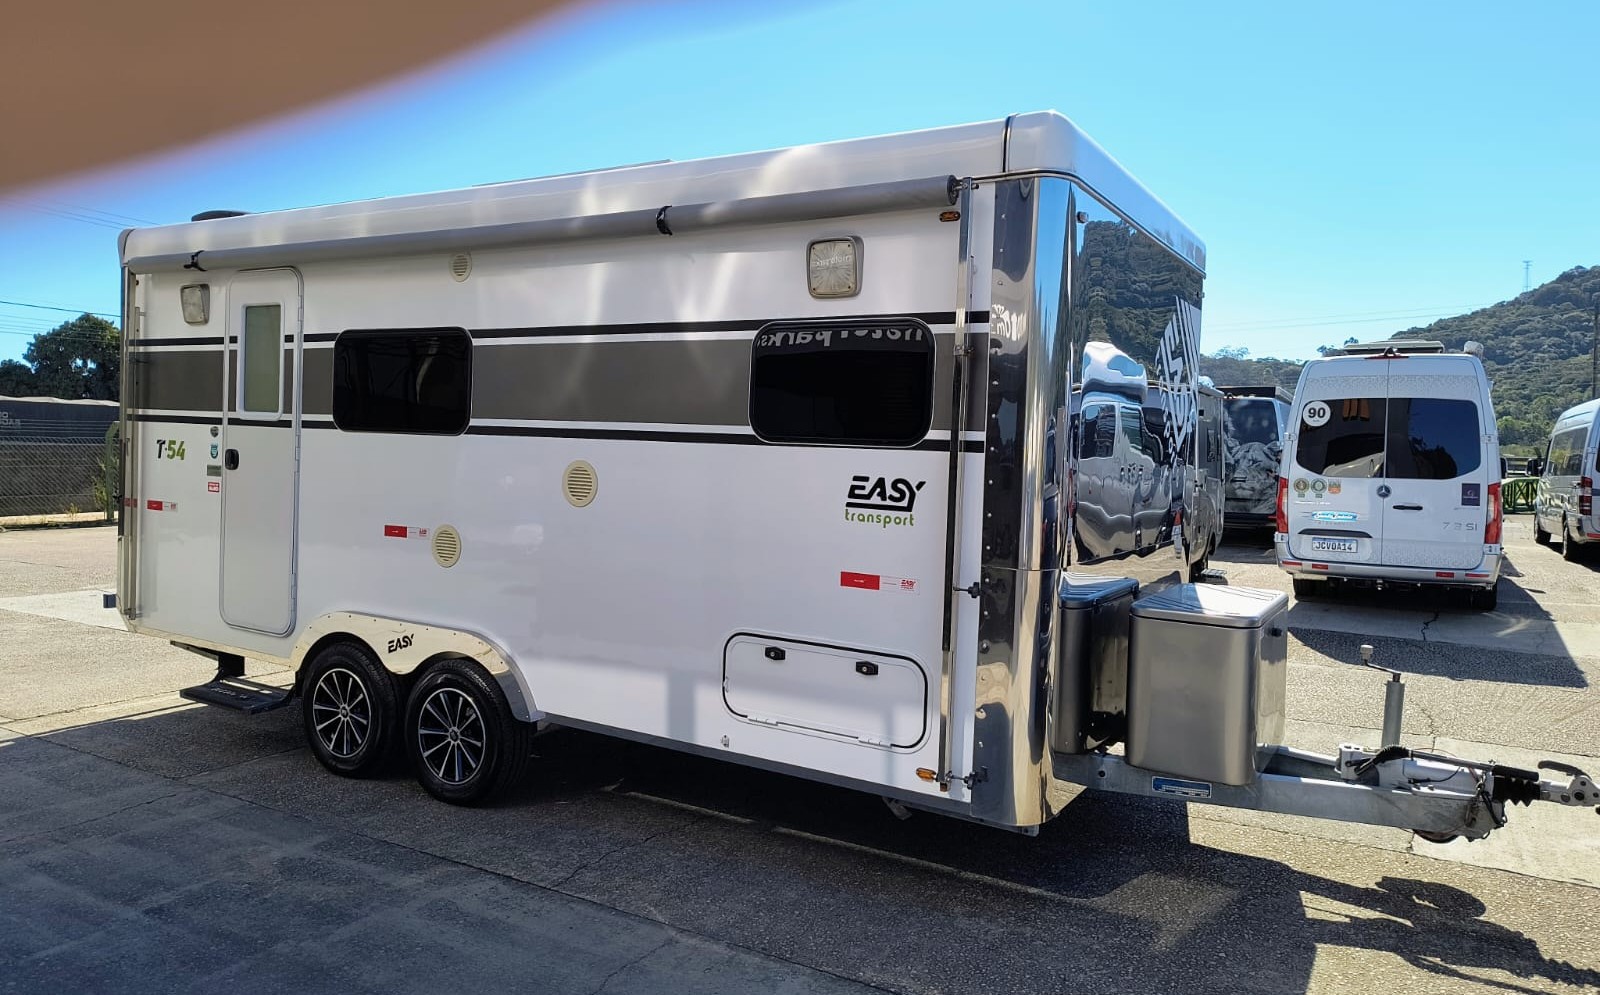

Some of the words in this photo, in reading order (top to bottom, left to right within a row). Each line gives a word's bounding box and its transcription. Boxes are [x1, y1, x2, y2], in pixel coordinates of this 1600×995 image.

[1308, 407, 1326, 418] 90
[846, 475, 927, 512] EASY
[844, 509, 915, 528] transport
[388, 633, 415, 654] EASY
